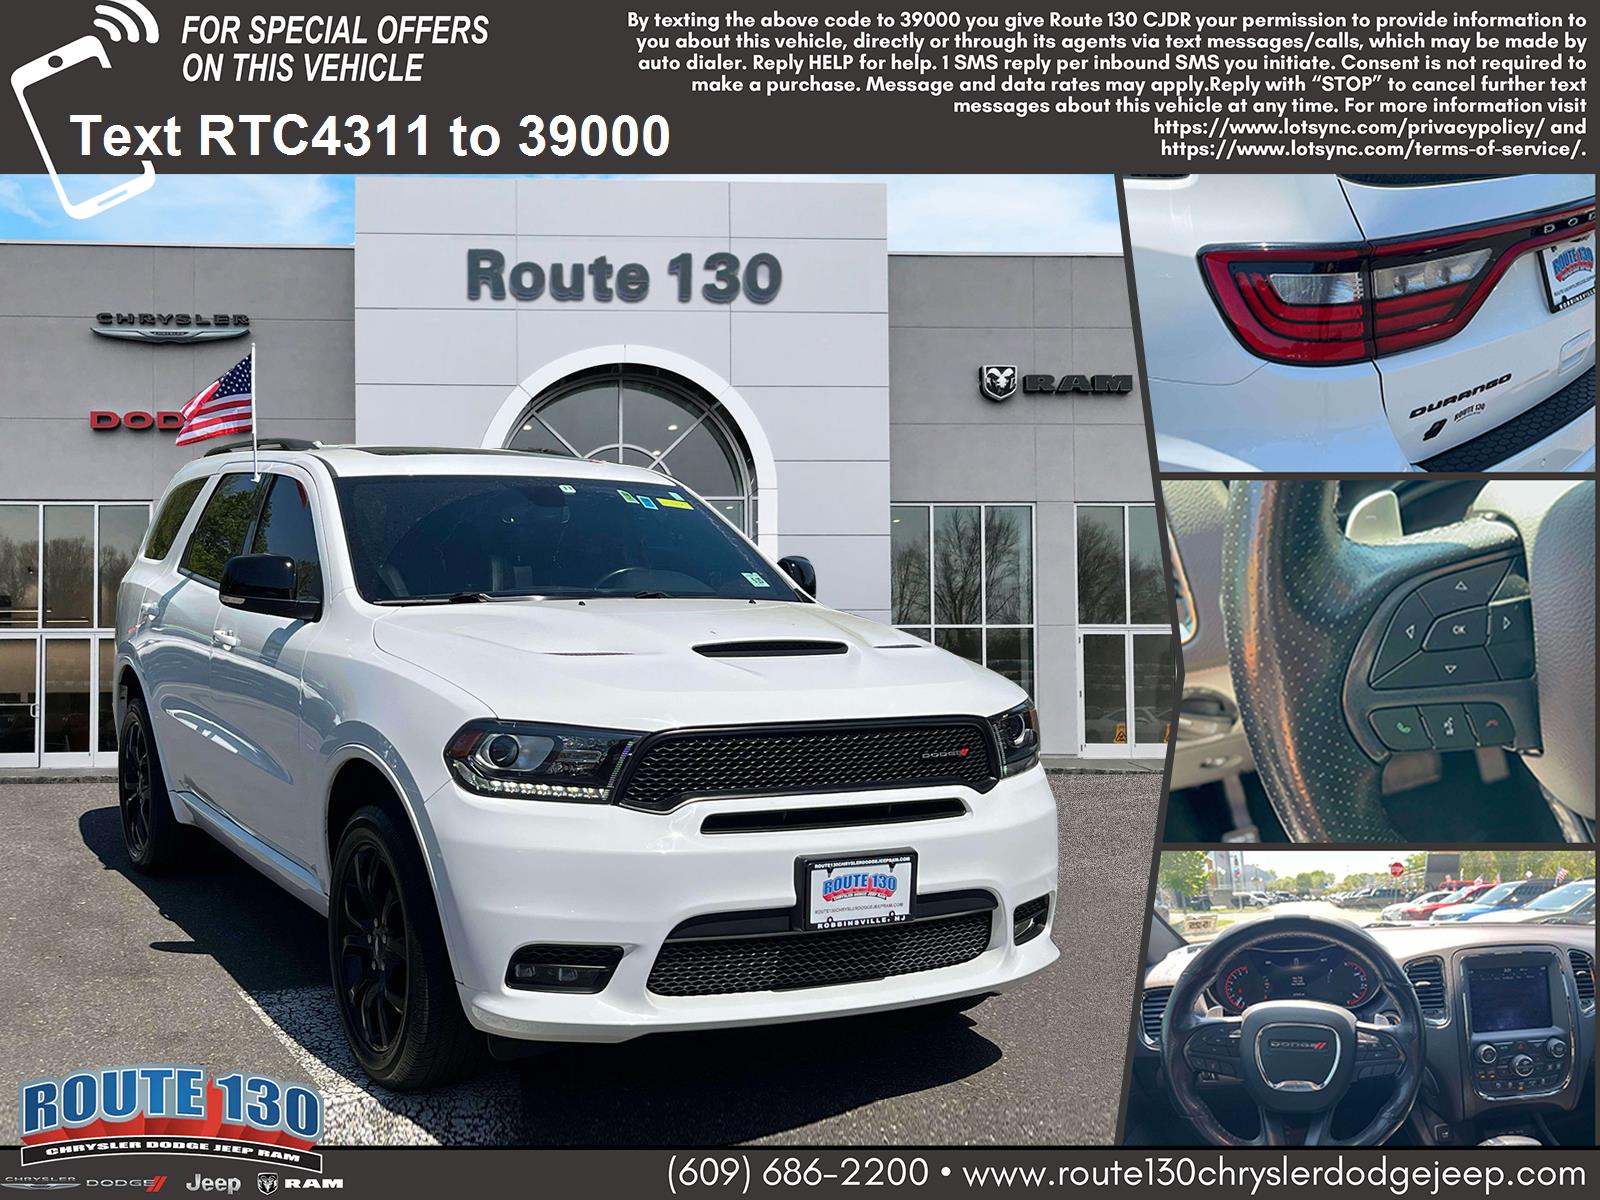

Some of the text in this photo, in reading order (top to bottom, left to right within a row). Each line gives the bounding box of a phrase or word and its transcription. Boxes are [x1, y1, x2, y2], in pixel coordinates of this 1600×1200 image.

[467, 248, 783, 305] Route 130
[96, 312, 250, 326] CHRYSLER
[1023, 374, 1133, 395] RAM
[1409, 373, 1513, 418] DURANGO
[90, 411, 185, 430] DOD
[1452, 625, 1466, 634] OK
[822, 873, 898, 894] ROUTE 130
